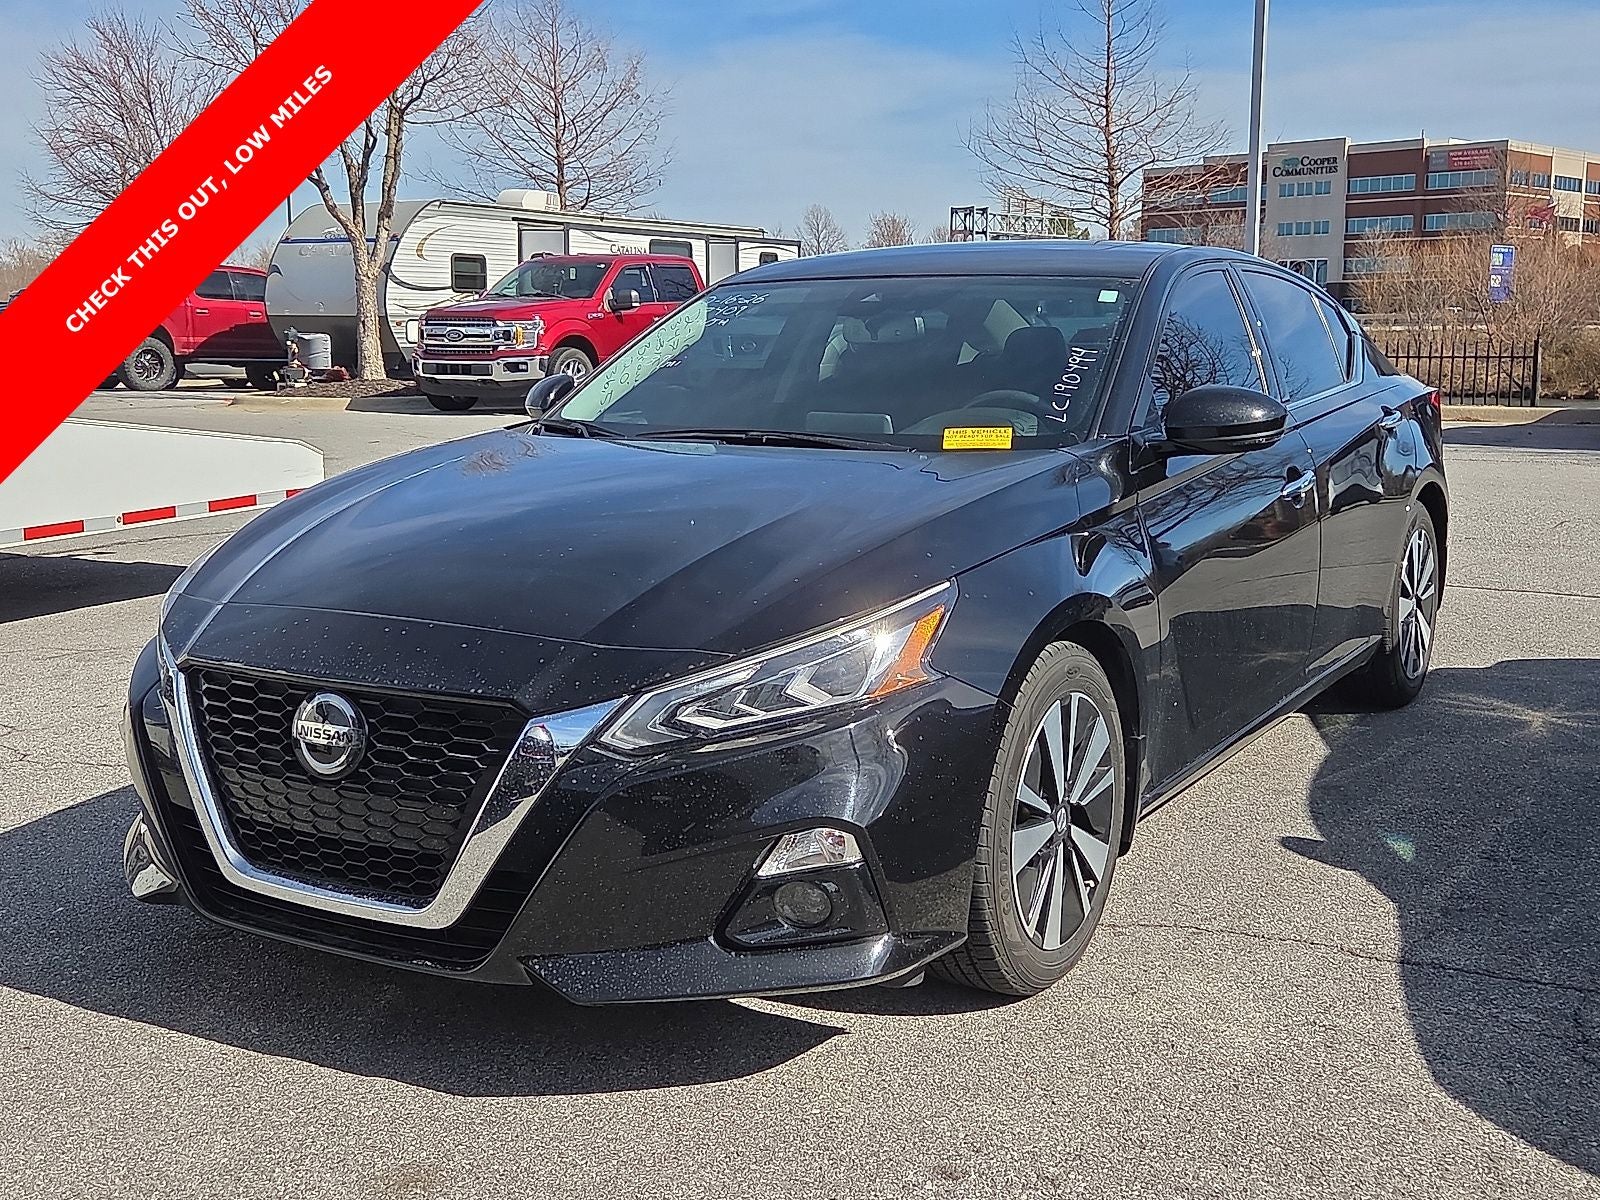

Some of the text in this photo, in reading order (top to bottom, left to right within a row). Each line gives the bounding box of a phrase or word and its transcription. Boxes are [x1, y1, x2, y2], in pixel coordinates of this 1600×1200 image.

[1301, 156, 1338, 166] COOPER
[1273, 166, 1338, 177] COMMUNITIES
[1045, 347, 1098, 422] LC190494
[299, 724, 353, 744] NISSAN
